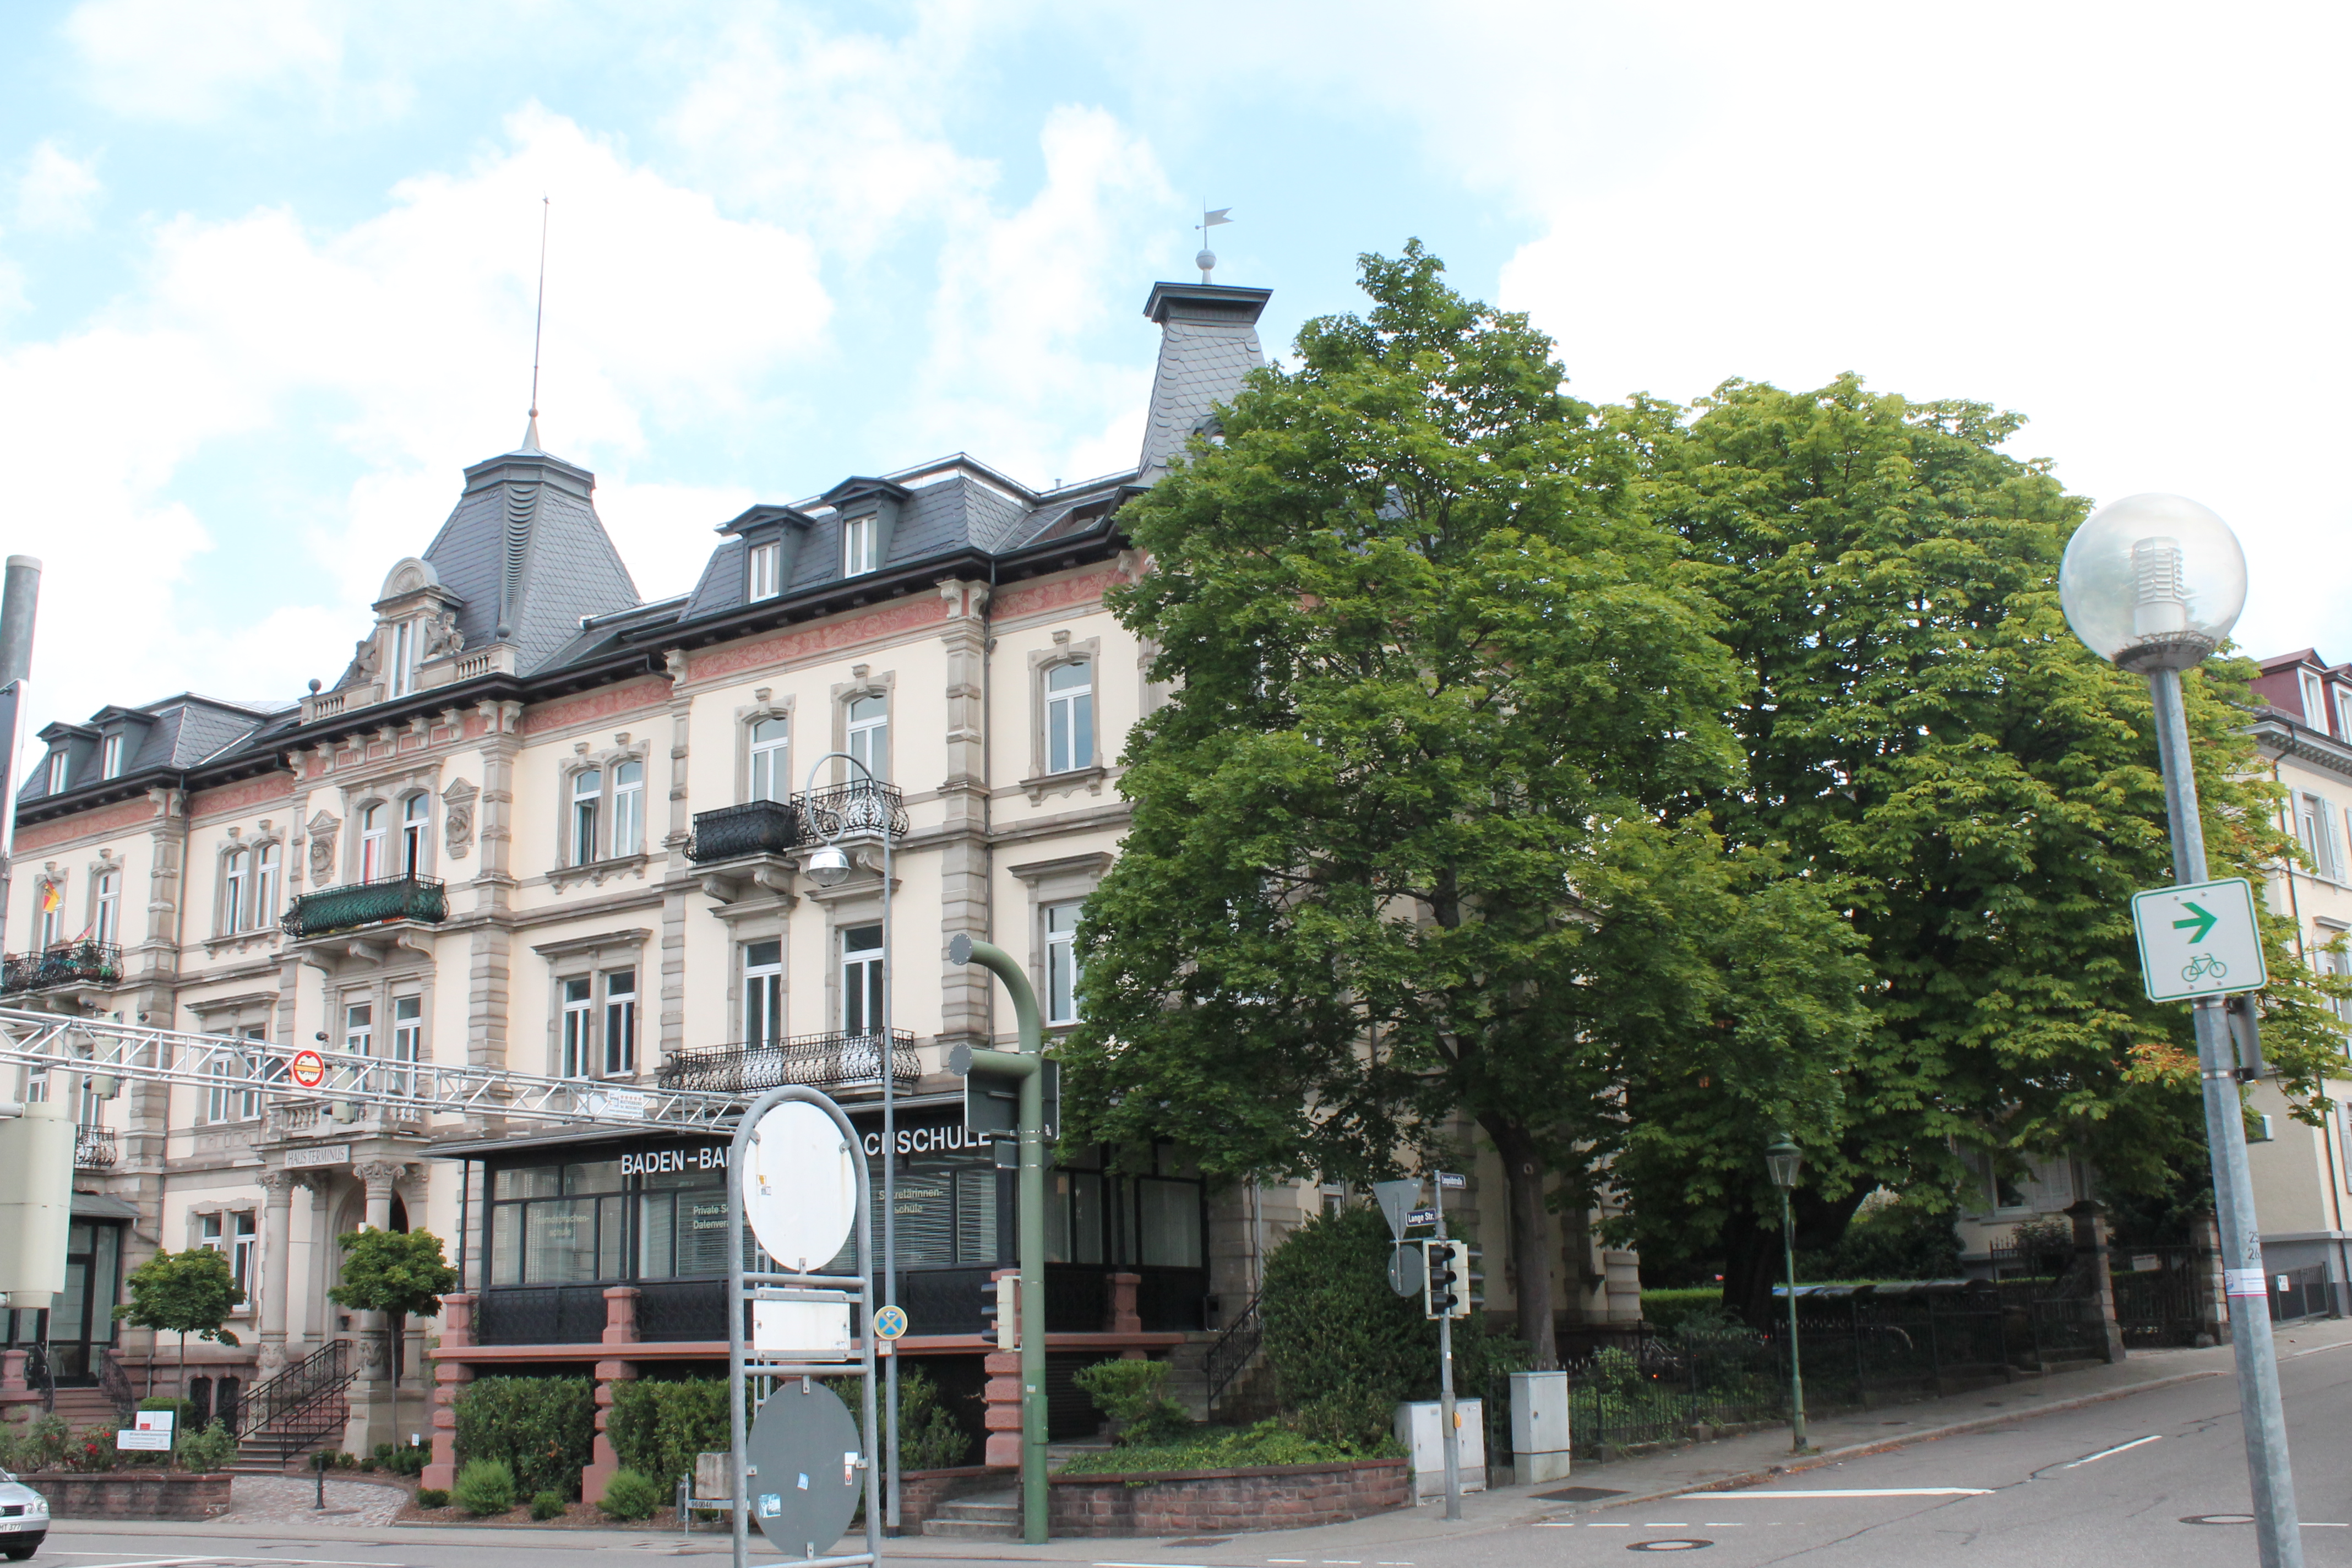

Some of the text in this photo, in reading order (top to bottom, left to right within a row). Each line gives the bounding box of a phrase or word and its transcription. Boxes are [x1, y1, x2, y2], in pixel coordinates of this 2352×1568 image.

[288, 1147, 344, 1165] HAUS TERMINUS
[622, 1146, 732, 1175] BADEN-BA
[879, 1188, 943, 1200] Sretärinnen-
[694, 1205, 719, 1215] Private
[1408, 1212, 1435, 1224] Lange Str.
